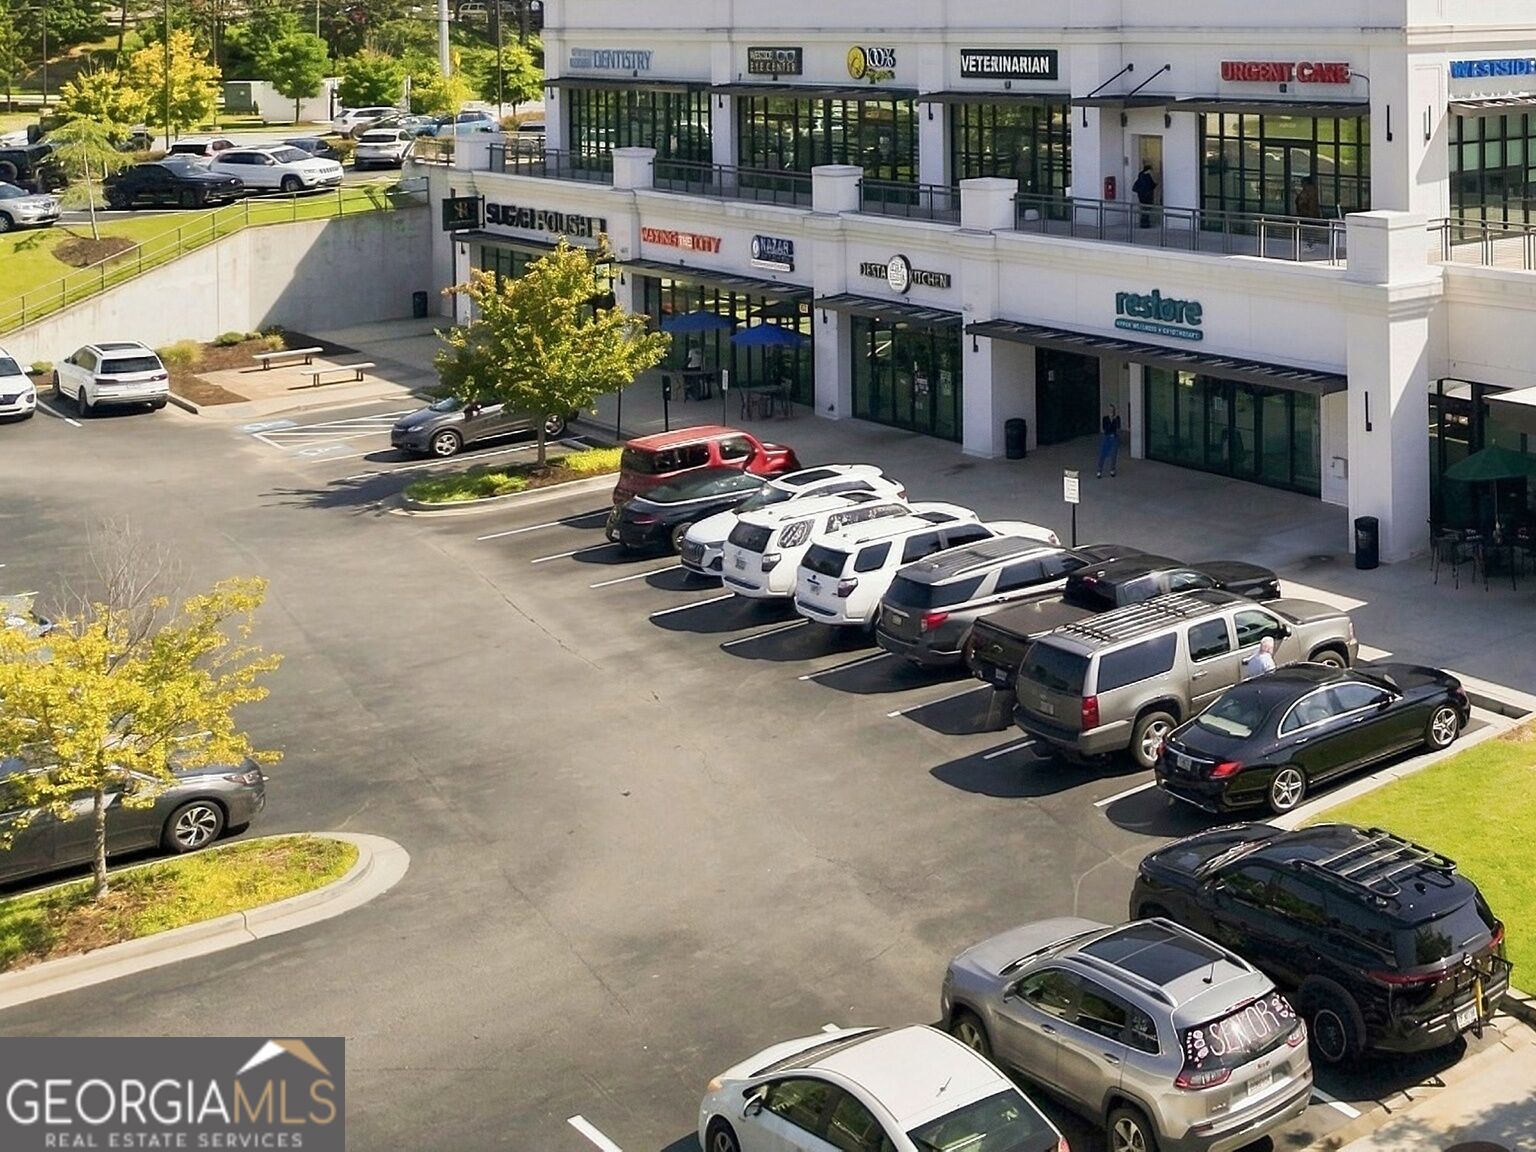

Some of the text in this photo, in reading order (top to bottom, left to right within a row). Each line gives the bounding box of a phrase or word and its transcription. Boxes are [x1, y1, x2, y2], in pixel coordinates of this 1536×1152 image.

[594, 49, 654, 69] DENTISTRY
[866, 47, 896, 68] 100%
[961, 54, 1050, 74] VETERINARIAN
[1221, 61, 1350, 84] URGENT CARE
[1115, 289, 1203, 326] restore
[1209, 999, 1281, 1056] SENOR
